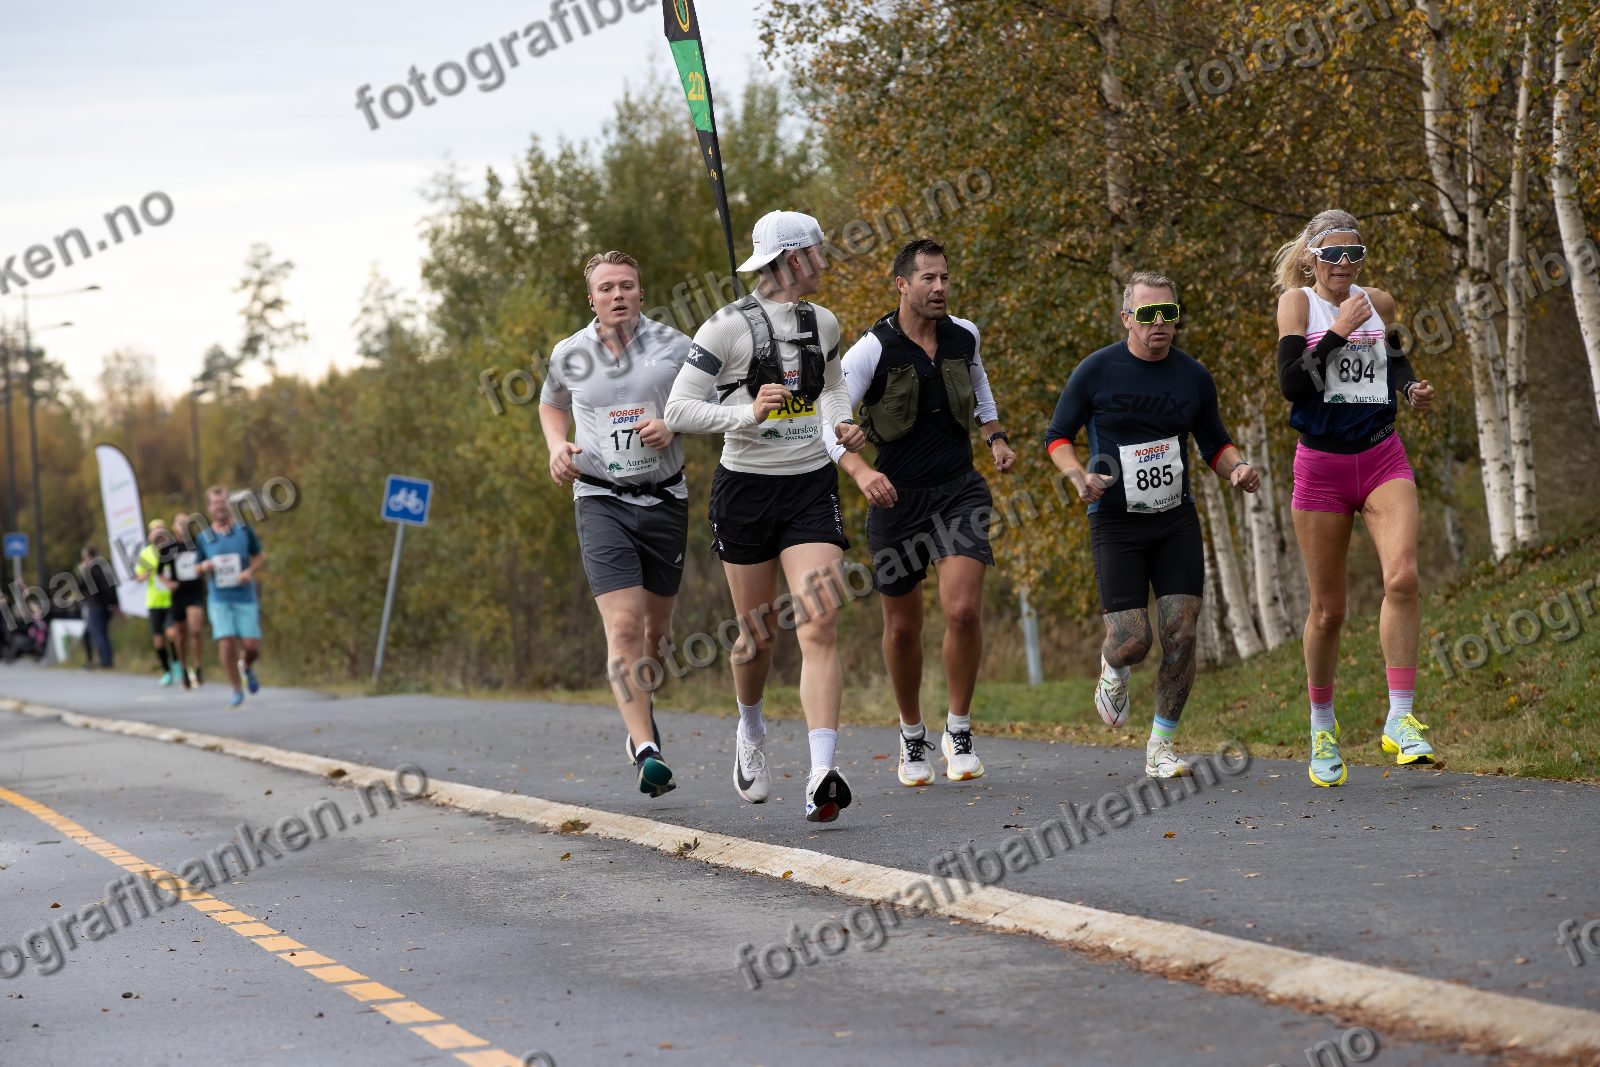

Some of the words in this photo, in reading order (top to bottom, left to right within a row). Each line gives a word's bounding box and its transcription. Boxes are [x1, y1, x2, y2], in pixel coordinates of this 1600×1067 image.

[1339, 357, 1376, 384] 894
[608, 407, 645, 418] NORGES
[1135, 443, 1170, 457] NORGES
[1136, 464, 1174, 491] 885
